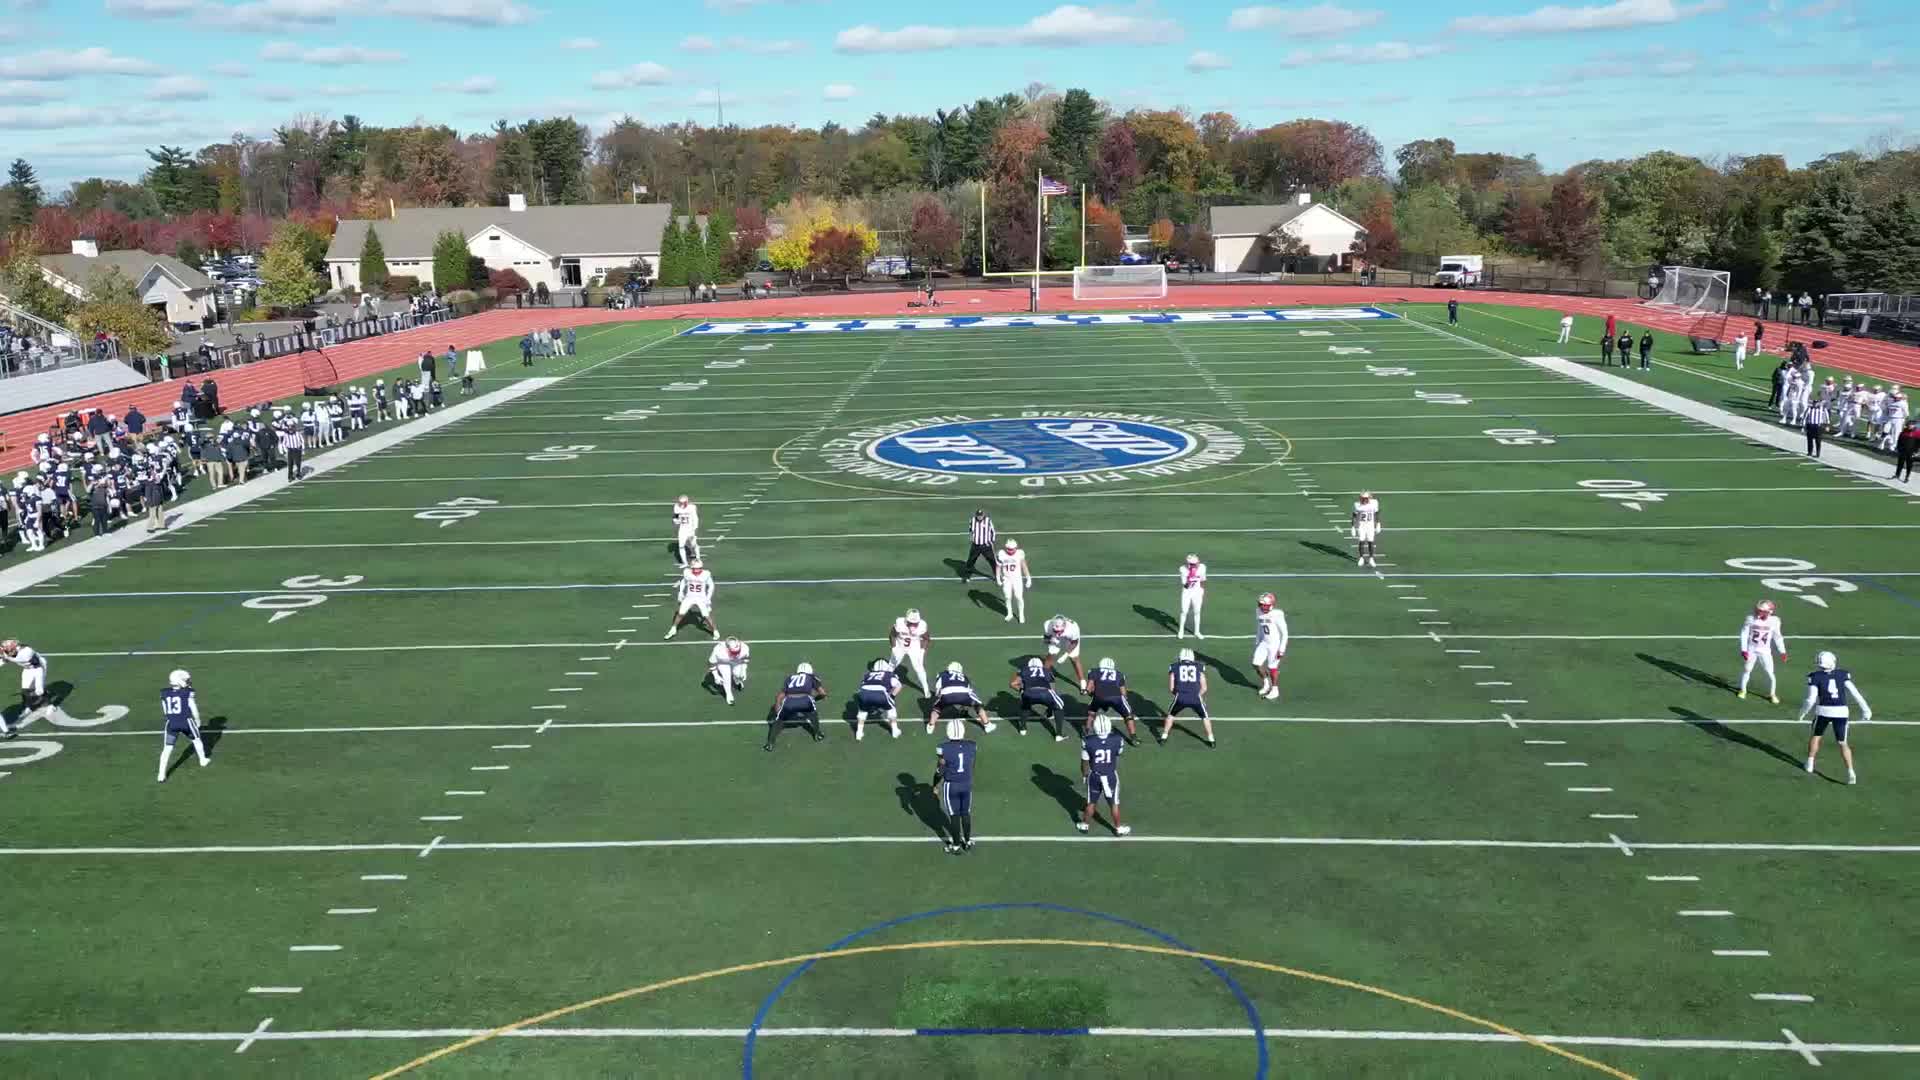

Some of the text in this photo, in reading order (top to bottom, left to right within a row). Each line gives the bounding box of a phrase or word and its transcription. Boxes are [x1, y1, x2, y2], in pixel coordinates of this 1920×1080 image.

[694, 309, 1388, 333] PIRATES
[1034, 421, 1180, 456] SHP
[1482, 428, 1557, 445] 50
[525, 444, 598, 462] 50
[895, 434, 1026, 470] BPT
[1020, 471, 1130, 487] FIELD
[1576, 479, 1668, 501] 40
[413, 496, 499, 520] 40
[1725, 557, 1858, 592] 30
[242, 575, 364, 609] 30
[689, 584, 702, 593] 25
[1752, 630, 1769, 645] 24
[788, 674, 807, 688] 70
[1030, 667, 1045, 678] 71
[1100, 669, 1116, 681] 73
[1179, 665, 1197, 682] 83
[1828, 679, 1839, 698] 4
[166, 697, 182, 714] 13
[957, 753, 964, 772] 1
[1094, 750, 1111, 763] 21
